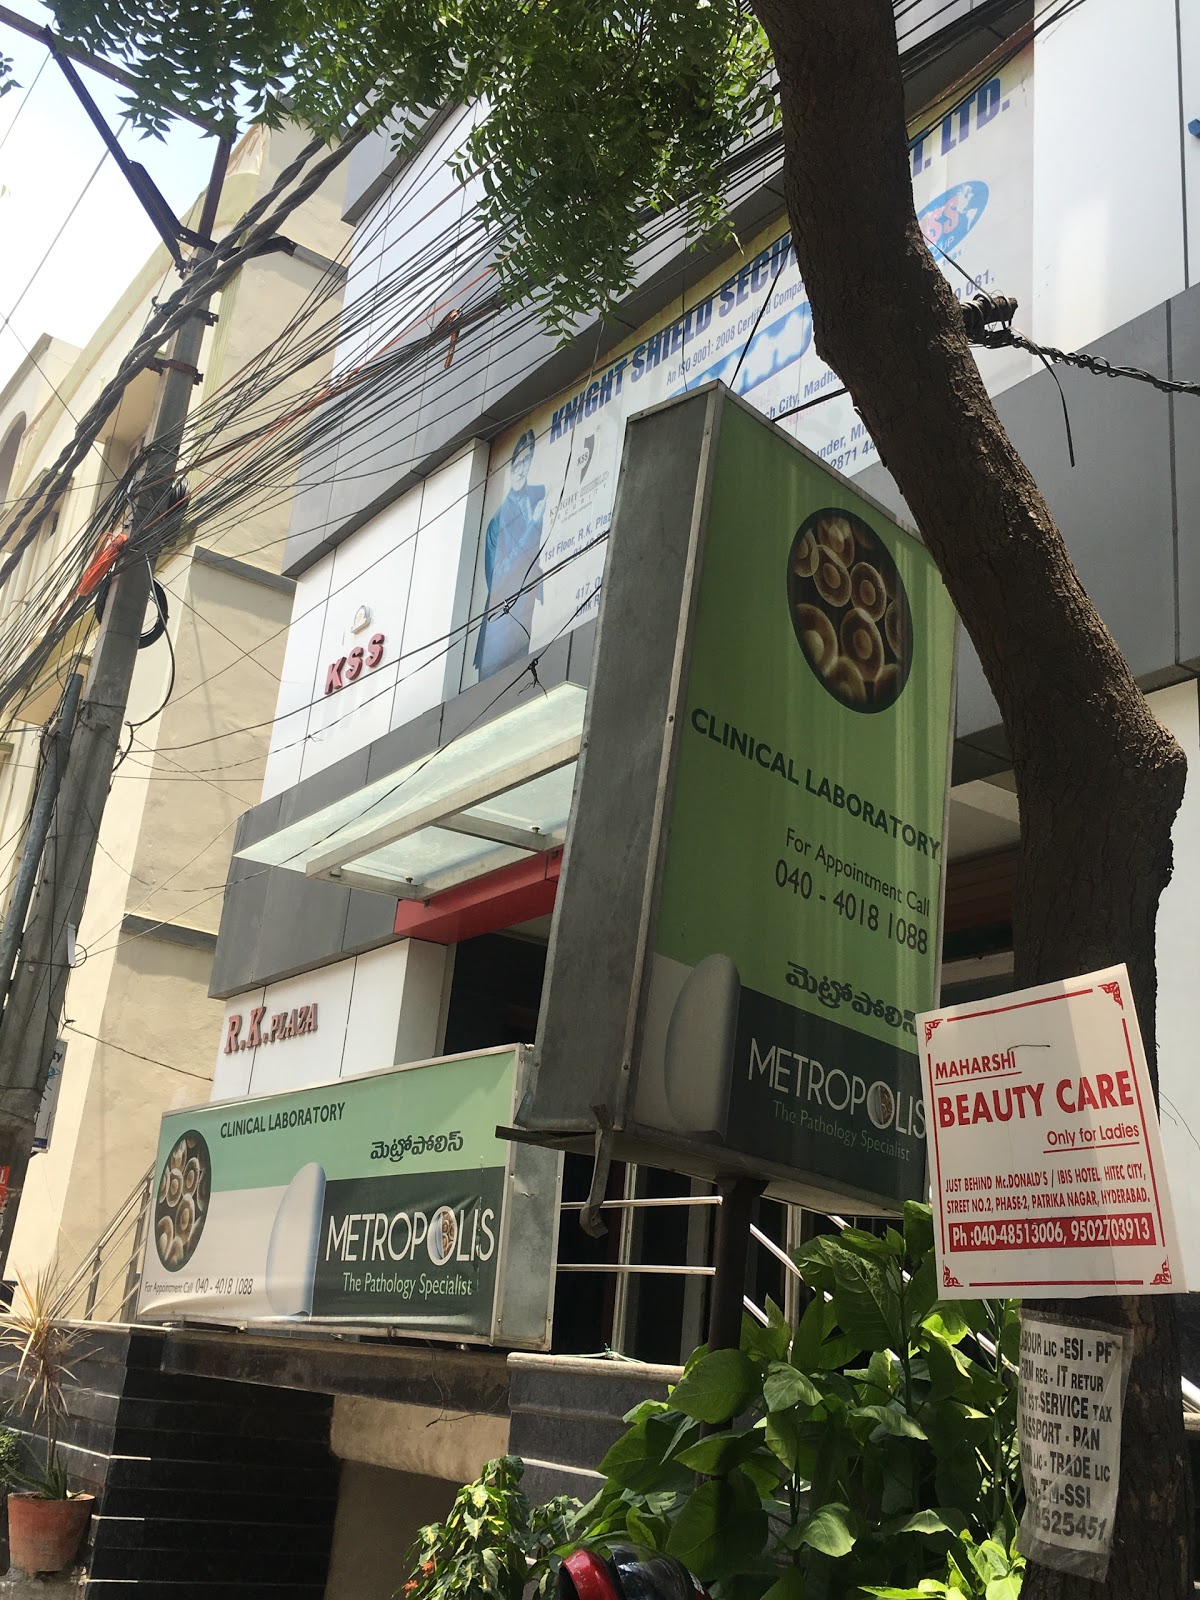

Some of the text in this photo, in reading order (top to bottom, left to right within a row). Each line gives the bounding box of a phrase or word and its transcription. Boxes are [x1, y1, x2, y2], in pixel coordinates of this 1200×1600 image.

[549, 357, 628, 444] KNIGHT
[631, 297, 713, 383] SHIELD
[941, 77, 1010, 157] LTD.
[666, 370, 677, 386] An
[716, 325, 736, 352] 2008
[737, 300, 771, 336] Certified
[804, 369, 839, 398] Madha
[576, 453, 589, 467] KSS
[544, 546, 556, 562] 1st
[557, 536, 576, 555] Floor,
[578, 522, 593, 542] R.K.
[595, 512, 612, 530] Plaz
[575, 582, 592, 600] 417,
[325, 633, 385, 695] KSS
[691, 708, 941, 860] CLINICAL LABORATORY
[786, 827, 930, 918] For Appointment Call
[775, 859, 813, 900] 040
[833, 889, 880, 932] 4018
[888, 912, 928, 955] 1088
[935, 1051, 1016, 1080] MAHARSHI
[748, 1037, 926, 1139] METROPOLIS
[938, 1070, 1135, 1128] BEAUTY CARE
[220, 1102, 345, 1139] CLINICAL LABORATORY
[773, 1100, 911, 1162] The Pathology Specialist
[1046, 1122, 1140, 1147] Only for Ladies
[945, 1178, 962, 1193] JUST
[964, 1175, 993, 1191] BEHIND
[995, 1171, 1049, 1190] Mc.DONALD'S
[1057, 1168, 1073, 1185] IBIS
[1104, 1164, 1125, 1181] HITEC
[1126, 1163, 1146, 1182] CITY,
[946, 1186, 1150, 1214] STREET NO.2, PHASE-2, PATRIKA NAGAR, HYDERABAD.
[325, 1205, 495, 1266] METROPOLIS
[952, 1224, 968, 1246] Ph
[1070, 1216, 1150, 1243] 9502703913
[144, 1281, 153, 1293] For
[153, 1281, 183, 1295] Appointment
[183, 1281, 194, 1294] Call
[195, 1278, 209, 1294] 040
[215, 1278, 234, 1294] 4018
[234, 1278, 254, 1295] 1088
[343, 1272, 473, 1300] The Pathology Specialist
[1043, 1340, 1057, 1357] LIC
[1095, 1341, 1112, 1363] PF
[1035, 1367, 1048, 1384] REG
[1057, 1364, 1068, 1387] IT
[1093, 1404, 1112, 1422] TAX
[1073, 1425, 1100, 1451] PAN
[1033, 1453, 1042, 1471] LIC
[1050, 1451, 1091, 1479] TRADE
[1094, 1464, 1111, 1482] LIC
